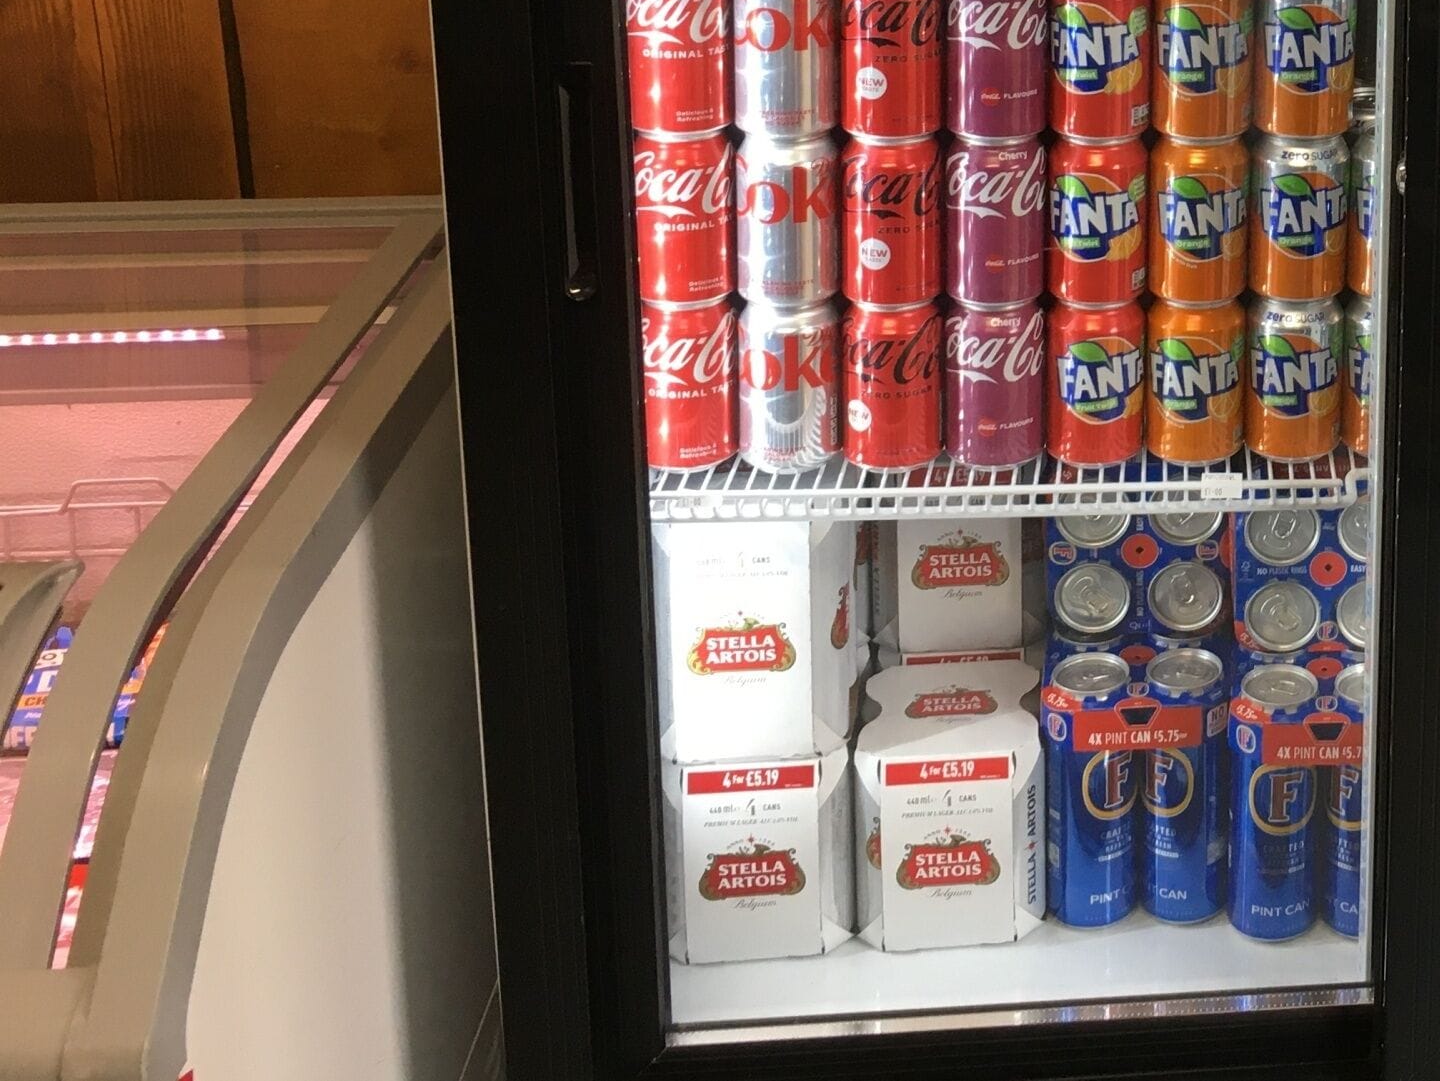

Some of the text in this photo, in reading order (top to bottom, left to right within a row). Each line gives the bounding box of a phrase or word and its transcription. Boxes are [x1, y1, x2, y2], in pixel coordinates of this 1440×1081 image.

[1051, 22, 1139, 68] FANTA
[1158, 22, 1248, 69] FANTA
[1265, 22, 1355, 69] FANTA
[642, 48, 704, 59] ORIGINAL
[874, 55, 909, 64] ZERO
[998, 151, 1028, 161] Cherry
[1281, 149, 1310, 161] zero
[1051, 190, 1139, 236] FANTA
[1158, 188, 1248, 237] FANTA
[1261, 185, 1348, 235] FANTA
[655, 221, 716, 232] ORIGINAL
[878, 226, 911, 235] ZERO
[861, 248, 889, 259] NEW
[990, 317, 1021, 328] Cherry
[1266, 311, 1293, 322] zero
[1151, 351, 1240, 399] FANTA
[1251, 350, 1340, 396] FANTA
[648, 388, 707, 399] ORIGINAL
[896, 384, 933, 398] SUGAR
[929, 552, 992, 567] STELLA
[929, 565, 993, 579] ARTOIS
[1350, 564, 1367, 573] EASY
[706, 635, 776, 651] STELLA
[706, 648, 778, 665] ARTOIS
[921, 703, 982, 713] ARTOIS
[923, 695, 981, 706] STELLA
[1211, 705, 1225, 720] NO
[1088, 729, 1180, 745] 4X PINT CAN £5.75
[1276, 747, 1291, 759] 4X
[1293, 746, 1316, 759] PINT
[1318, 745, 1340, 758] CAN
[919, 763, 929, 779] 4
[942, 760, 975, 778] £5.19
[722, 773, 732, 788] 4
[746, 769, 780, 787] £5.19
[763, 804, 781, 812] CANS
[1027, 783, 1037, 905] STELLA ARTOIS
[915, 851, 981, 866] STELLA
[718, 860, 787, 876] STELLA
[915, 863, 982, 879] ARTOIS
[717, 874, 788, 890] ARTOIS
[1089, 890, 1119, 905] PINT
[1158, 888, 1188, 902] CAN
[1251, 897, 1310, 918] PINT CAN
